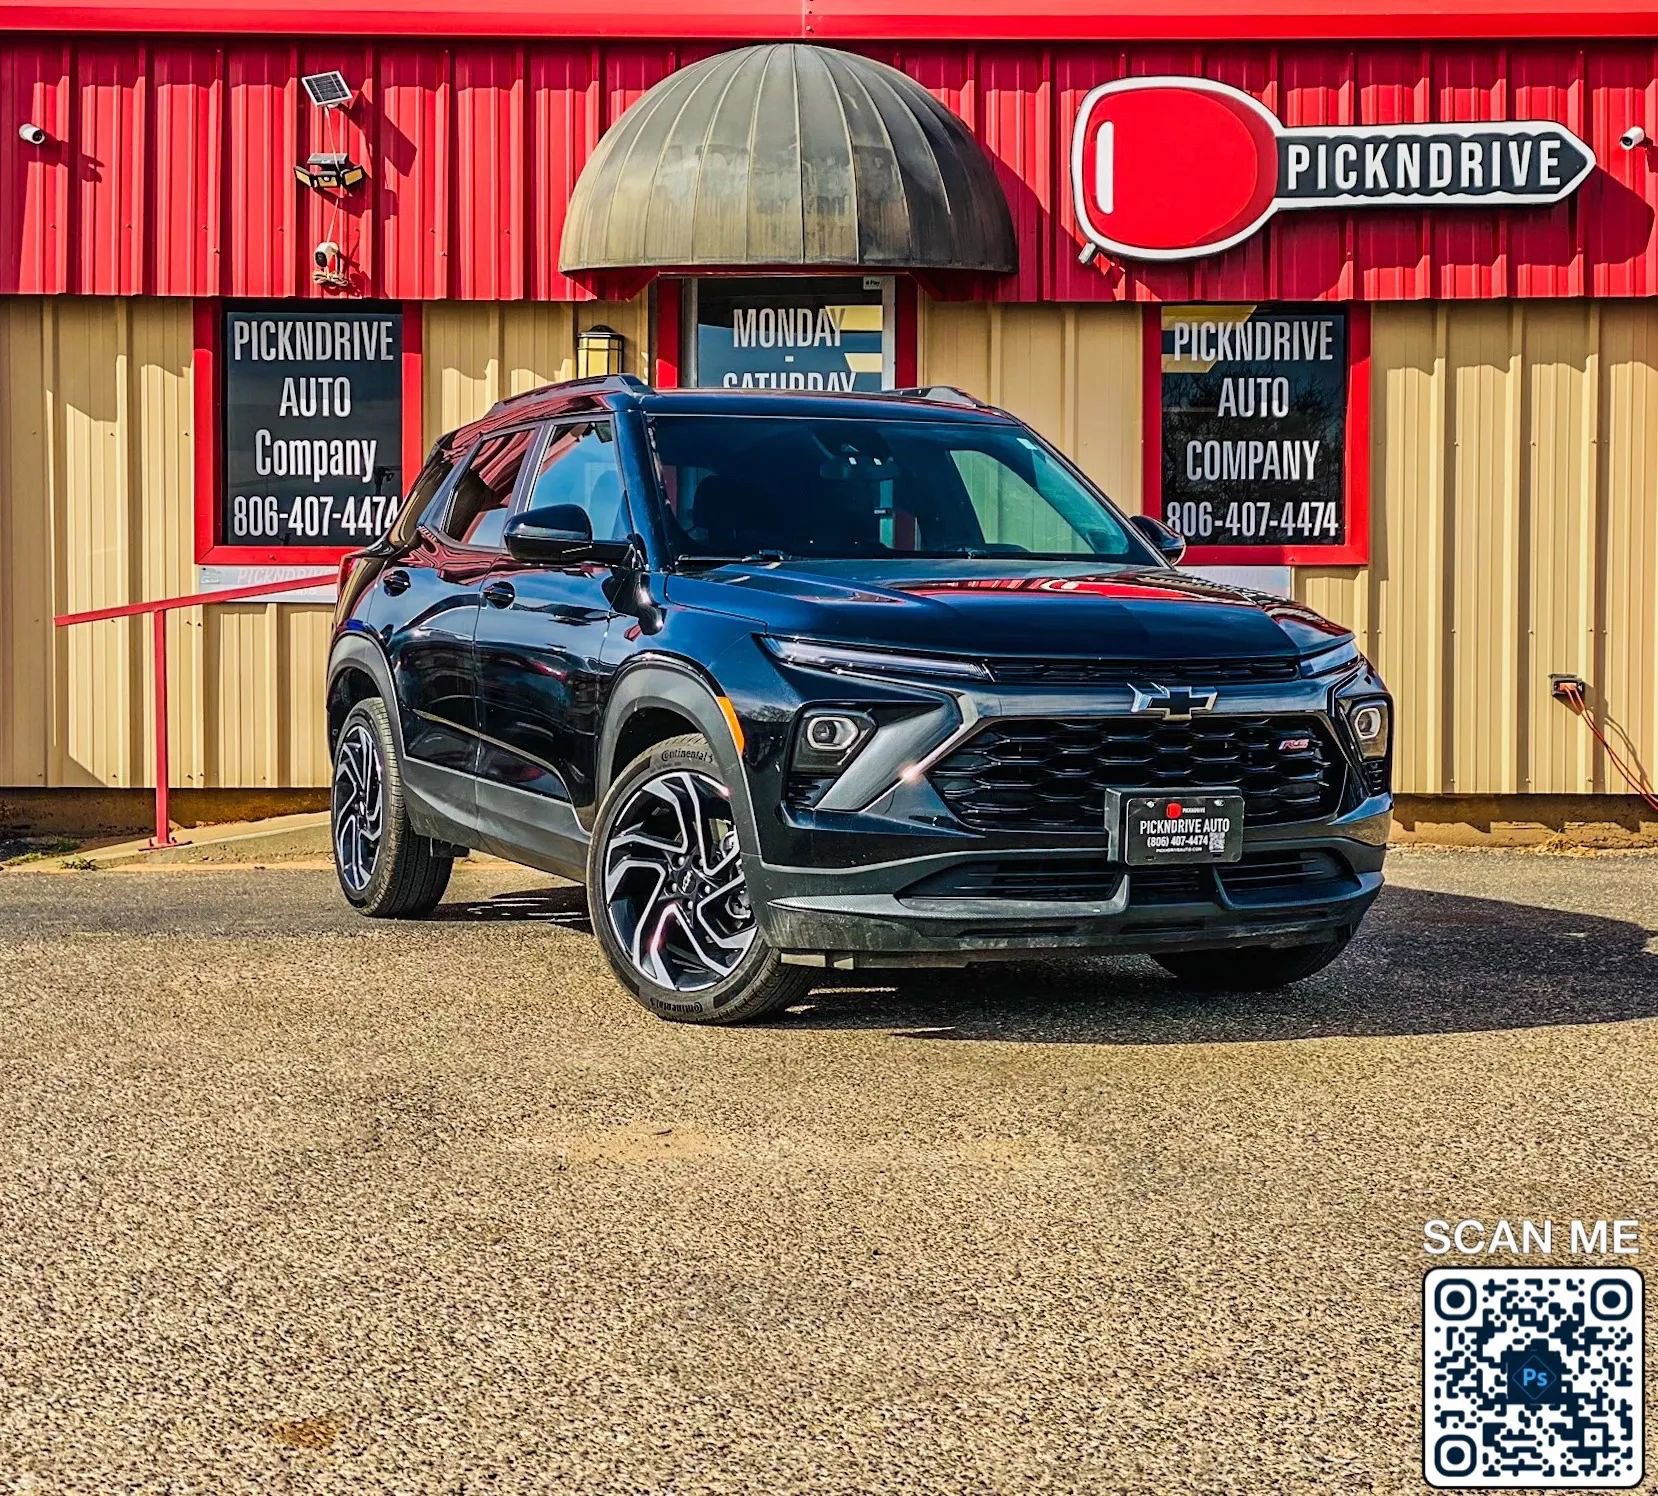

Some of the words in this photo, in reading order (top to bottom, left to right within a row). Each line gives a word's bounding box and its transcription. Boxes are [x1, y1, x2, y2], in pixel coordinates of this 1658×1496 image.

[1287, 139, 1562, 191] PICKNDRIVE
[233, 320, 395, 361] PICKNDRIVE
[732, 307, 846, 348] MONDAY
[1173, 320, 1334, 361] PICKNDRIVE
[278, 376, 351, 418] AUTO
[1217, 376, 1290, 418] AUTO
[254, 428, 377, 483] Company
[1186, 439, 1320, 481] COMPANY
[233, 495, 399, 538] 806-407-4474
[1166, 500, 1339, 537] 806-407-4474
[1278, 738, 1310, 751] RS
[1139, 818, 1202, 835] PICKNDRIVE
[1202, 818, 1231, 833] AUTO
[1146, 836, 1170, 848] (806)
[1170, 835, 1209, 847] 407-4474
